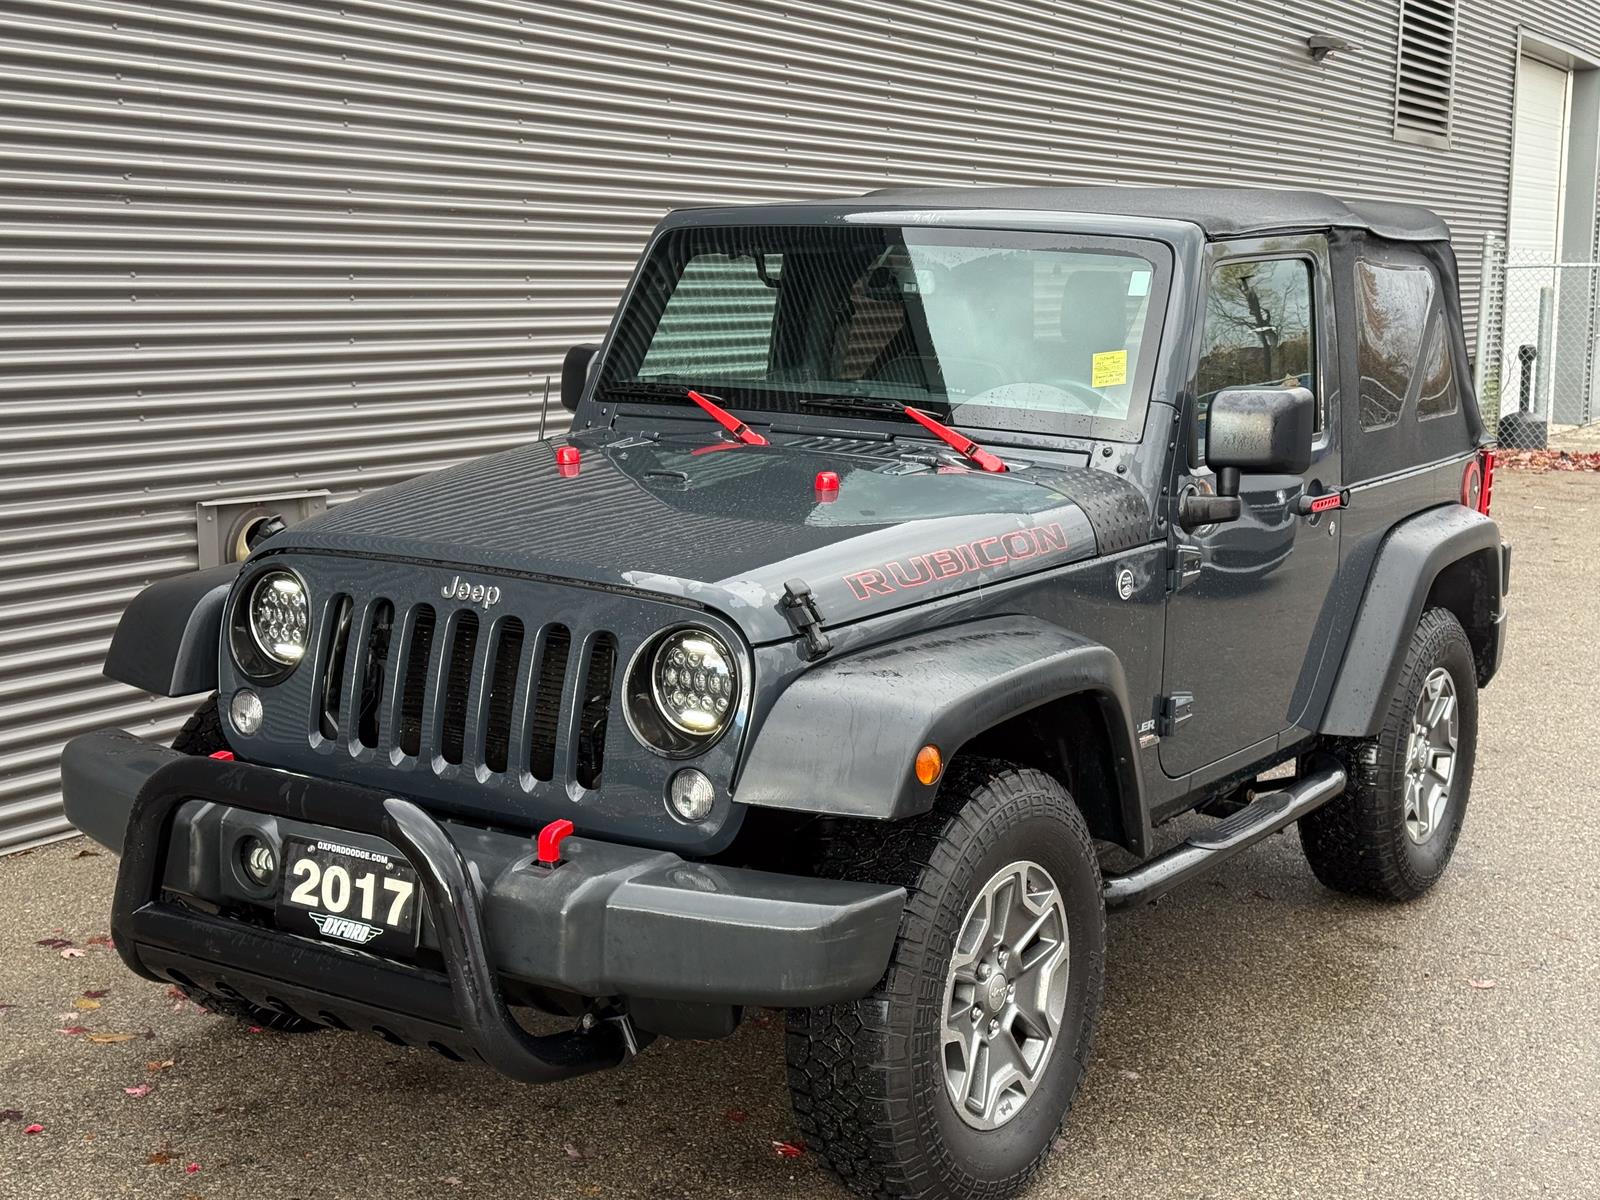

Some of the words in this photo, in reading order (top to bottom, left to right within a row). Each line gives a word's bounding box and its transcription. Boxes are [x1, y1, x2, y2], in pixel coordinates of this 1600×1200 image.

[842, 523, 1068, 600] RUBICON
[441, 575, 501, 609] Jeep
[317, 841, 388, 864] OXFORDDODGE.COM
[290, 858, 413, 926] 2017
[321, 917, 371, 942] OXFORD
